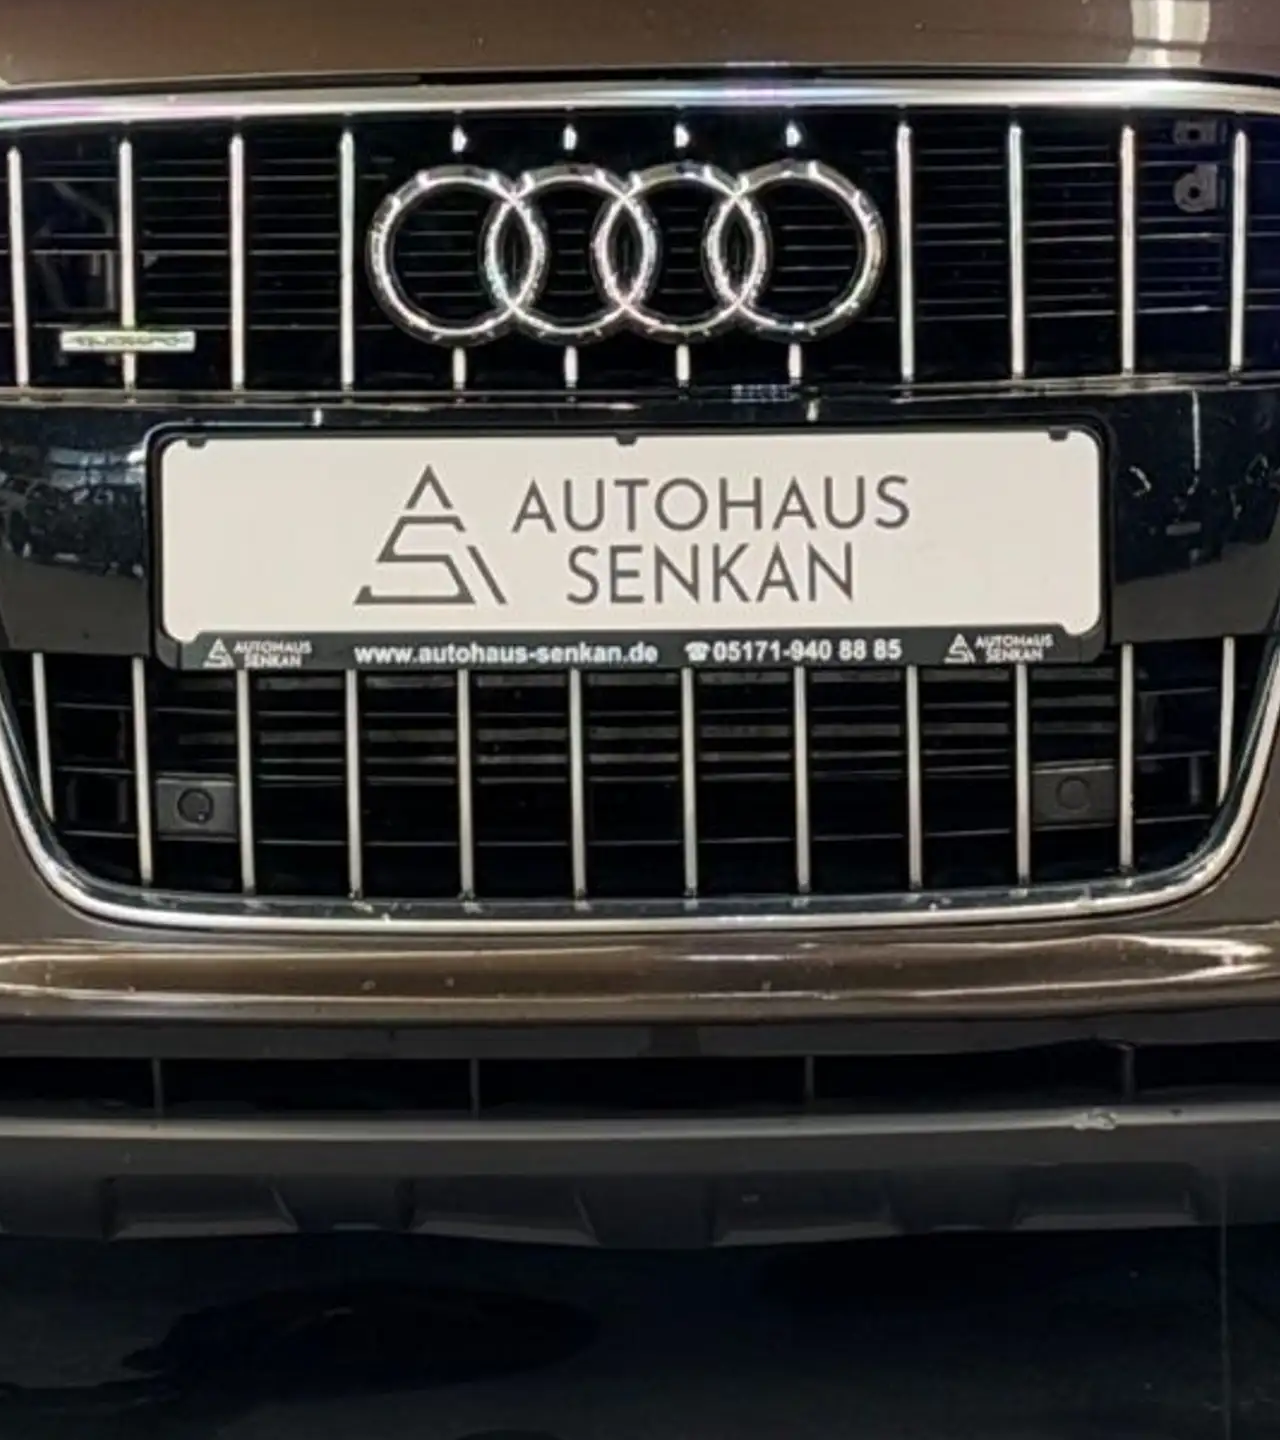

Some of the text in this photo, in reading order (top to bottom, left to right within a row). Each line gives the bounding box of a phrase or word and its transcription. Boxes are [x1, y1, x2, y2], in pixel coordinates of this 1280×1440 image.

[510, 474, 912, 534] AUTOHAUS
[565, 540, 855, 605] SENKAN
[232, 639, 313, 655] AUTOHAUS
[352, 640, 660, 666] www.autohaus-senkan.de
[711, 637, 904, 662] 05171-940 88 85
[974, 633, 1055, 649] AUTOHAUS
